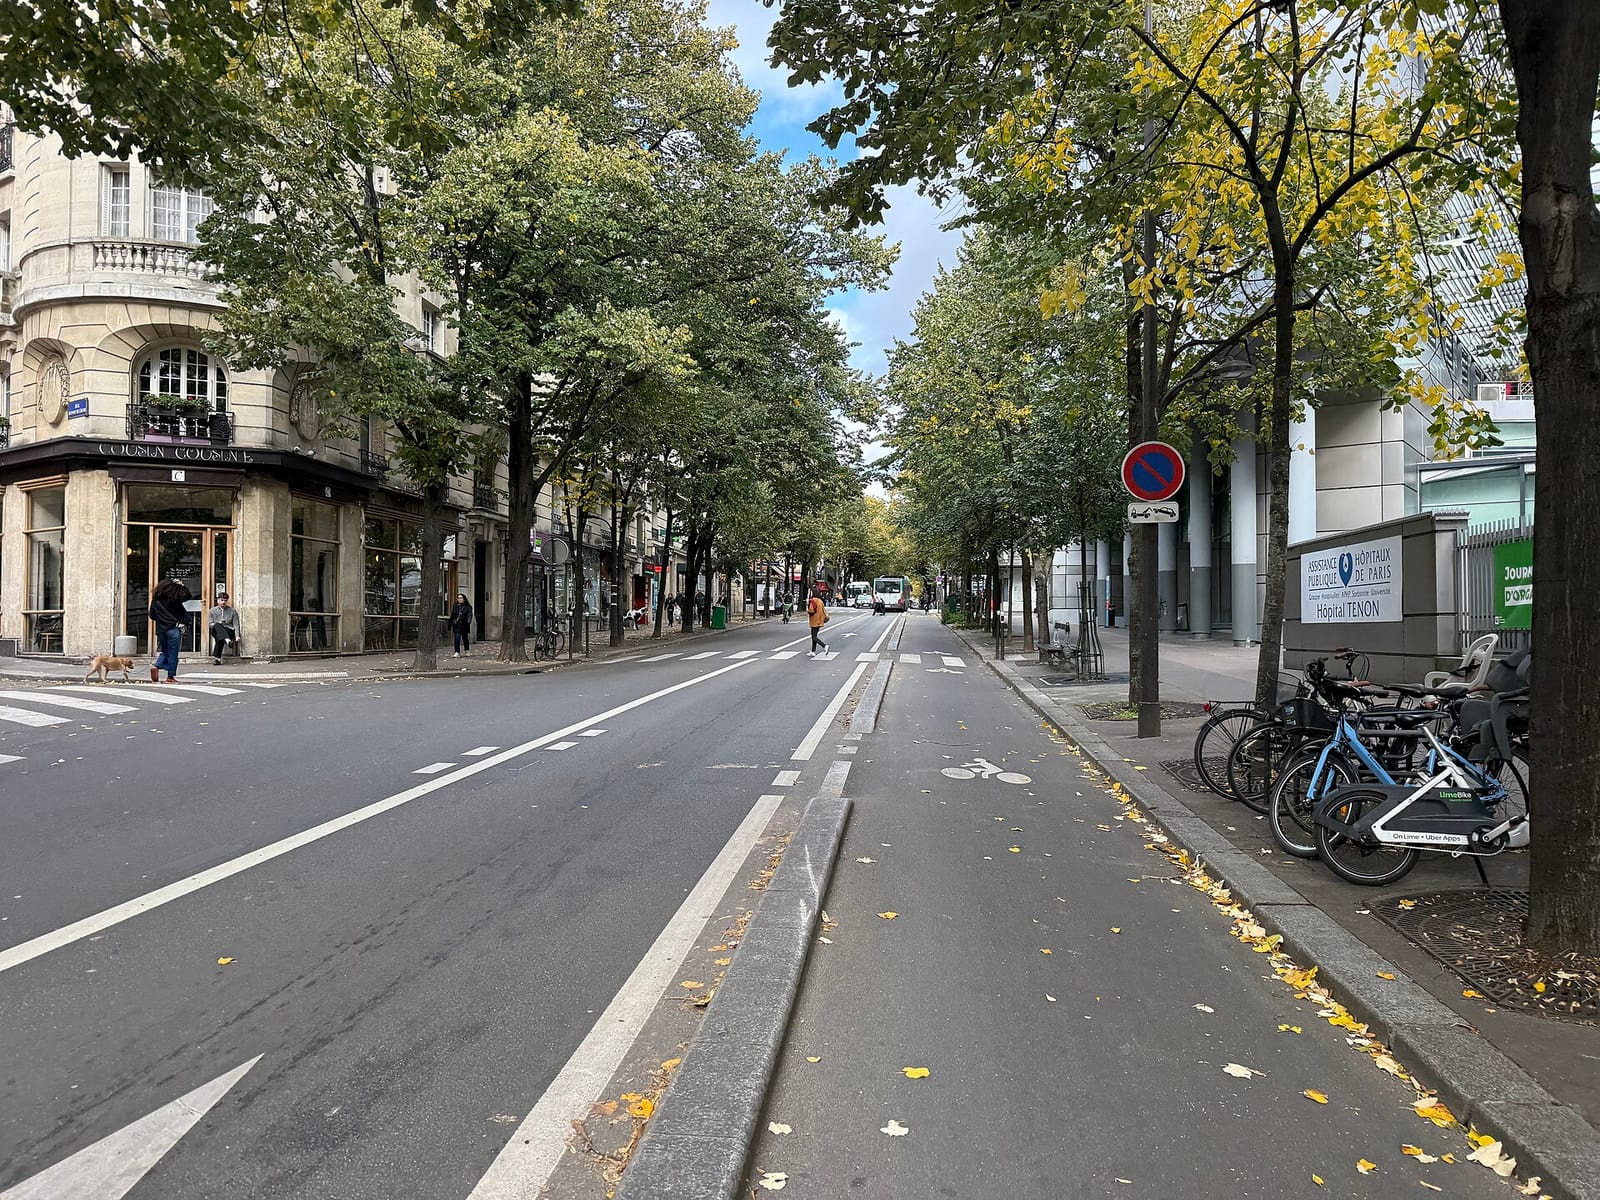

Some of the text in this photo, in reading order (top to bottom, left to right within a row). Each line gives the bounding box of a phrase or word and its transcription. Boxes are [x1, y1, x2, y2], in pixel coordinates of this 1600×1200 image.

[99, 443, 164, 457] COUSIN
[1308, 557, 1337, 573] ASSISTANCE
[1355, 548, 1391, 566] HÔPITAUX
[1308, 573, 1337, 588] PUBLIQUE
[1355, 565, 1391, 582] DE PARIS
[1317, 600, 1379, 621] Hôpital TENON
[1440, 791, 1472, 799] LimeBike
